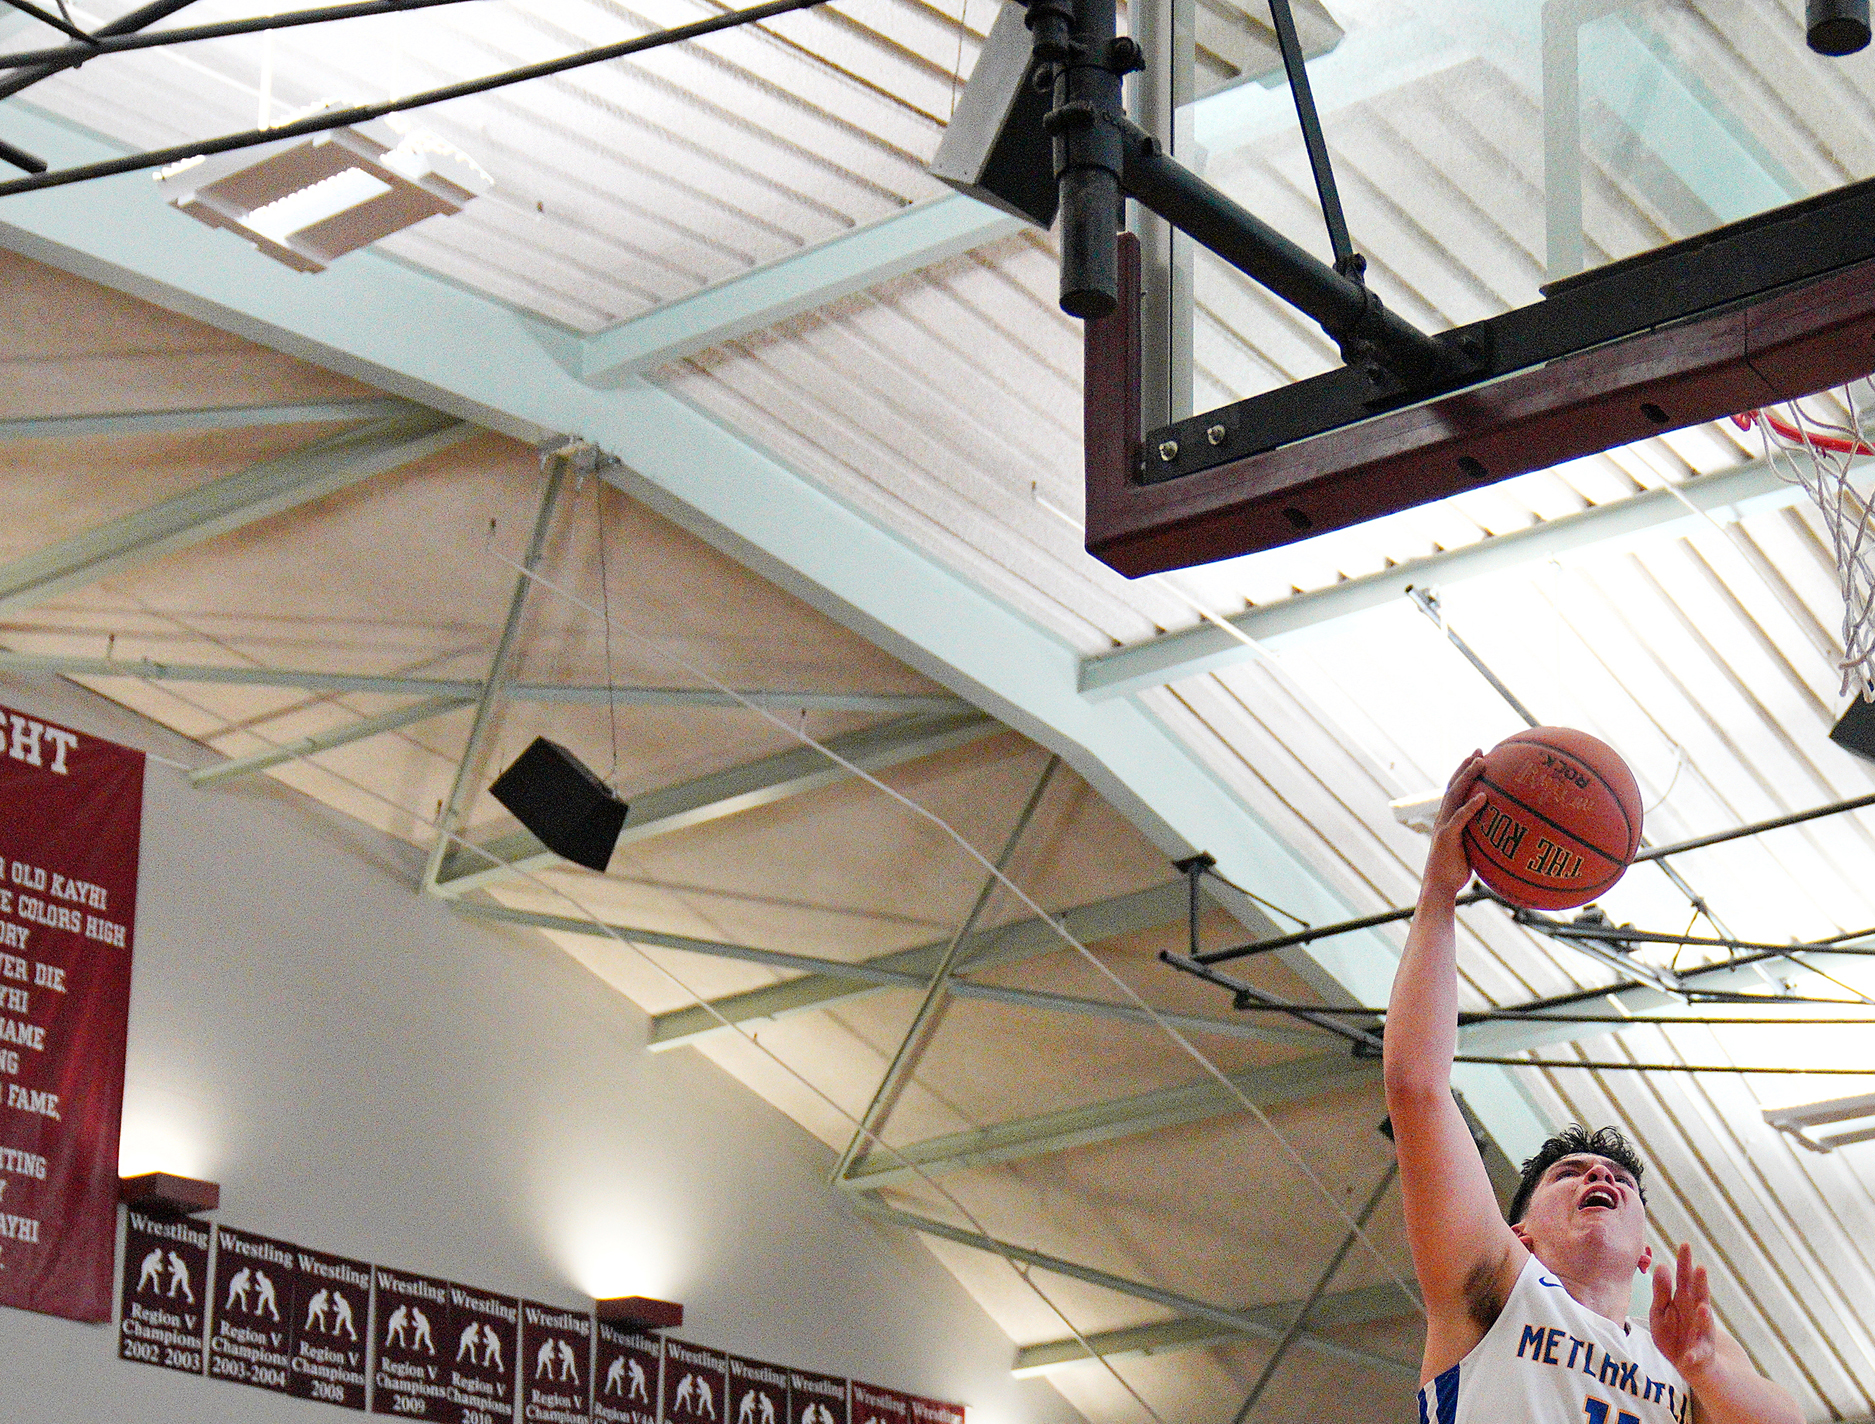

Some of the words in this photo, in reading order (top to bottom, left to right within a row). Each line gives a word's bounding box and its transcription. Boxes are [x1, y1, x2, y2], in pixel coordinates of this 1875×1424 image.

[0, 711, 78, 775] HT
[1526, 837, 1584, 879] THE
[11, 861, 47, 891] OLD
[51, 873, 107, 911] KAYHI
[18, 895, 81, 934] COLORS
[85, 915, 126, 948] HIGH
[130, 1211, 208, 1249] Wrestling
[218, 1231, 293, 1270] Wrestling
[298, 1252, 370, 1291] Wrestling
[377, 1272, 446, 1304] Wrestling
[131, 1302, 179, 1327] Region
[184, 1314, 197, 1330] V
[451, 1287, 517, 1323] Wrestling
[121, 1319, 202, 1350] Champions
[220, 1320, 267, 1346] Region
[270, 1332, 283, 1348] V
[525, 1307, 590, 1336] Wrestling
[211, 1336, 288, 1366] Champions
[300, 1340, 344, 1365] Region
[347, 1352, 359, 1367] V
[600, 1323, 661, 1357] Wrestling
[212, 1356, 287, 1387] 2003-2004
[291, 1356, 365, 1386] Champions
[381, 1357, 425, 1379] Region
[427, 1364, 439, 1381] V
[668, 1343, 727, 1373] Wrestling
[376, 1372, 446, 1399] Champions
[452, 1371, 494, 1396] Region
[496, 1382, 507, 1398] V
[730, 1359, 788, 1389] Wrestling
[792, 1374, 845, 1401] Wrestling
[311, 1380, 345, 1402] 2008
[447, 1386, 512, 1415] Champions
[531, 1388, 573, 1410] Region
[573, 1395, 583, 1410] V
[594, 1402, 630, 1422] Region
